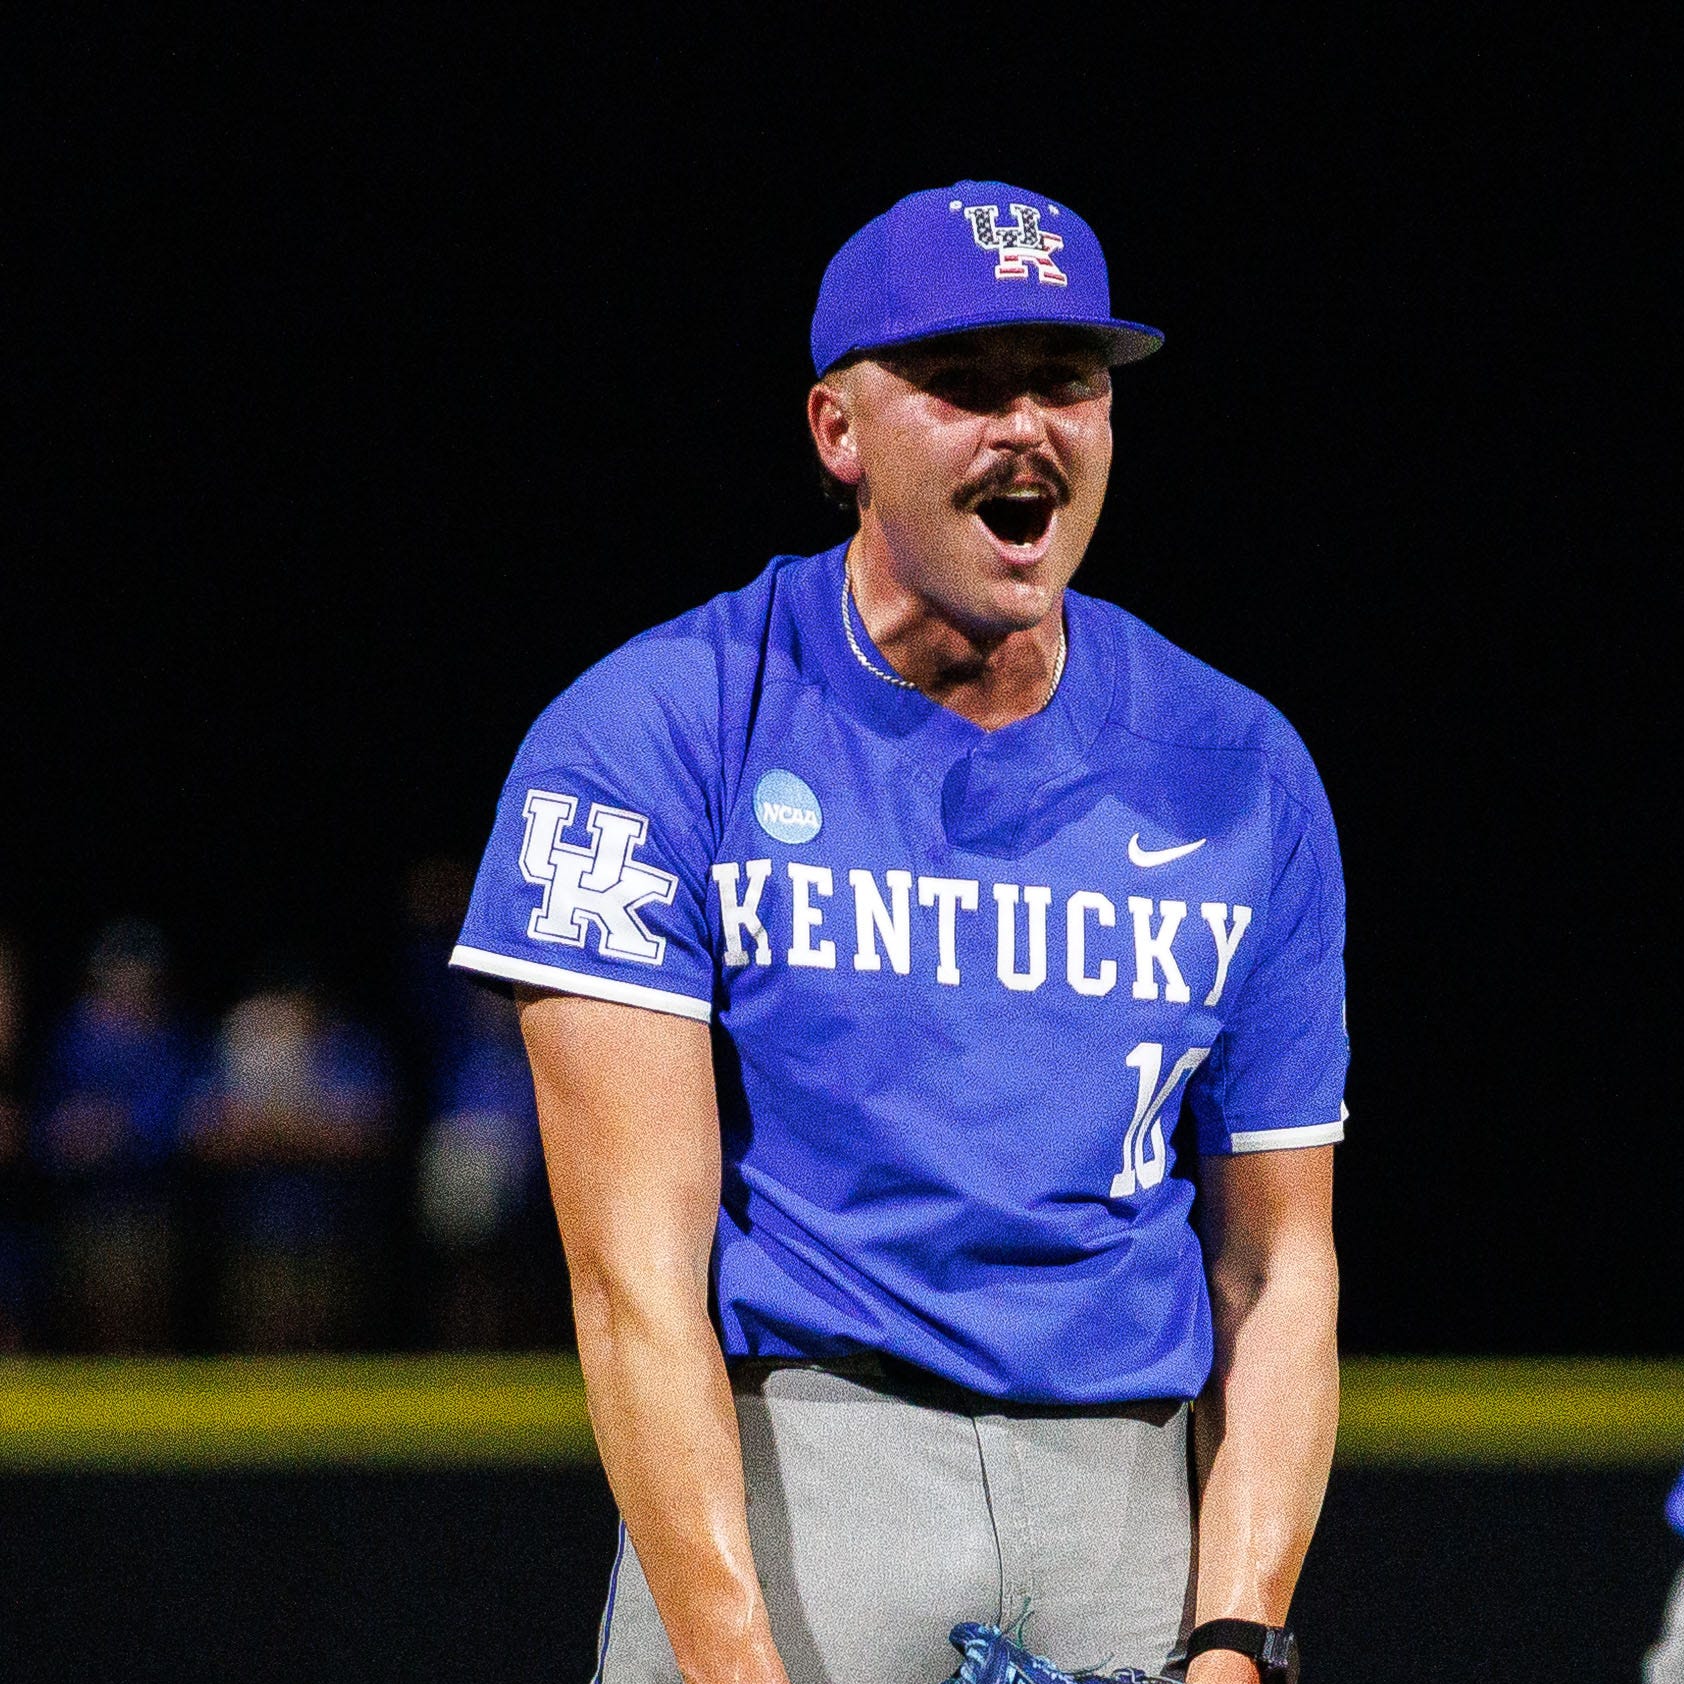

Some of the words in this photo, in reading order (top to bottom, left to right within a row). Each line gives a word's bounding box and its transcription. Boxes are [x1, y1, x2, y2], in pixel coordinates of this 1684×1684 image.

[519, 788, 679, 966] UK
[762, 801, 819, 829] NCAA
[711, 857, 1253, 1006] KENTUCKY
